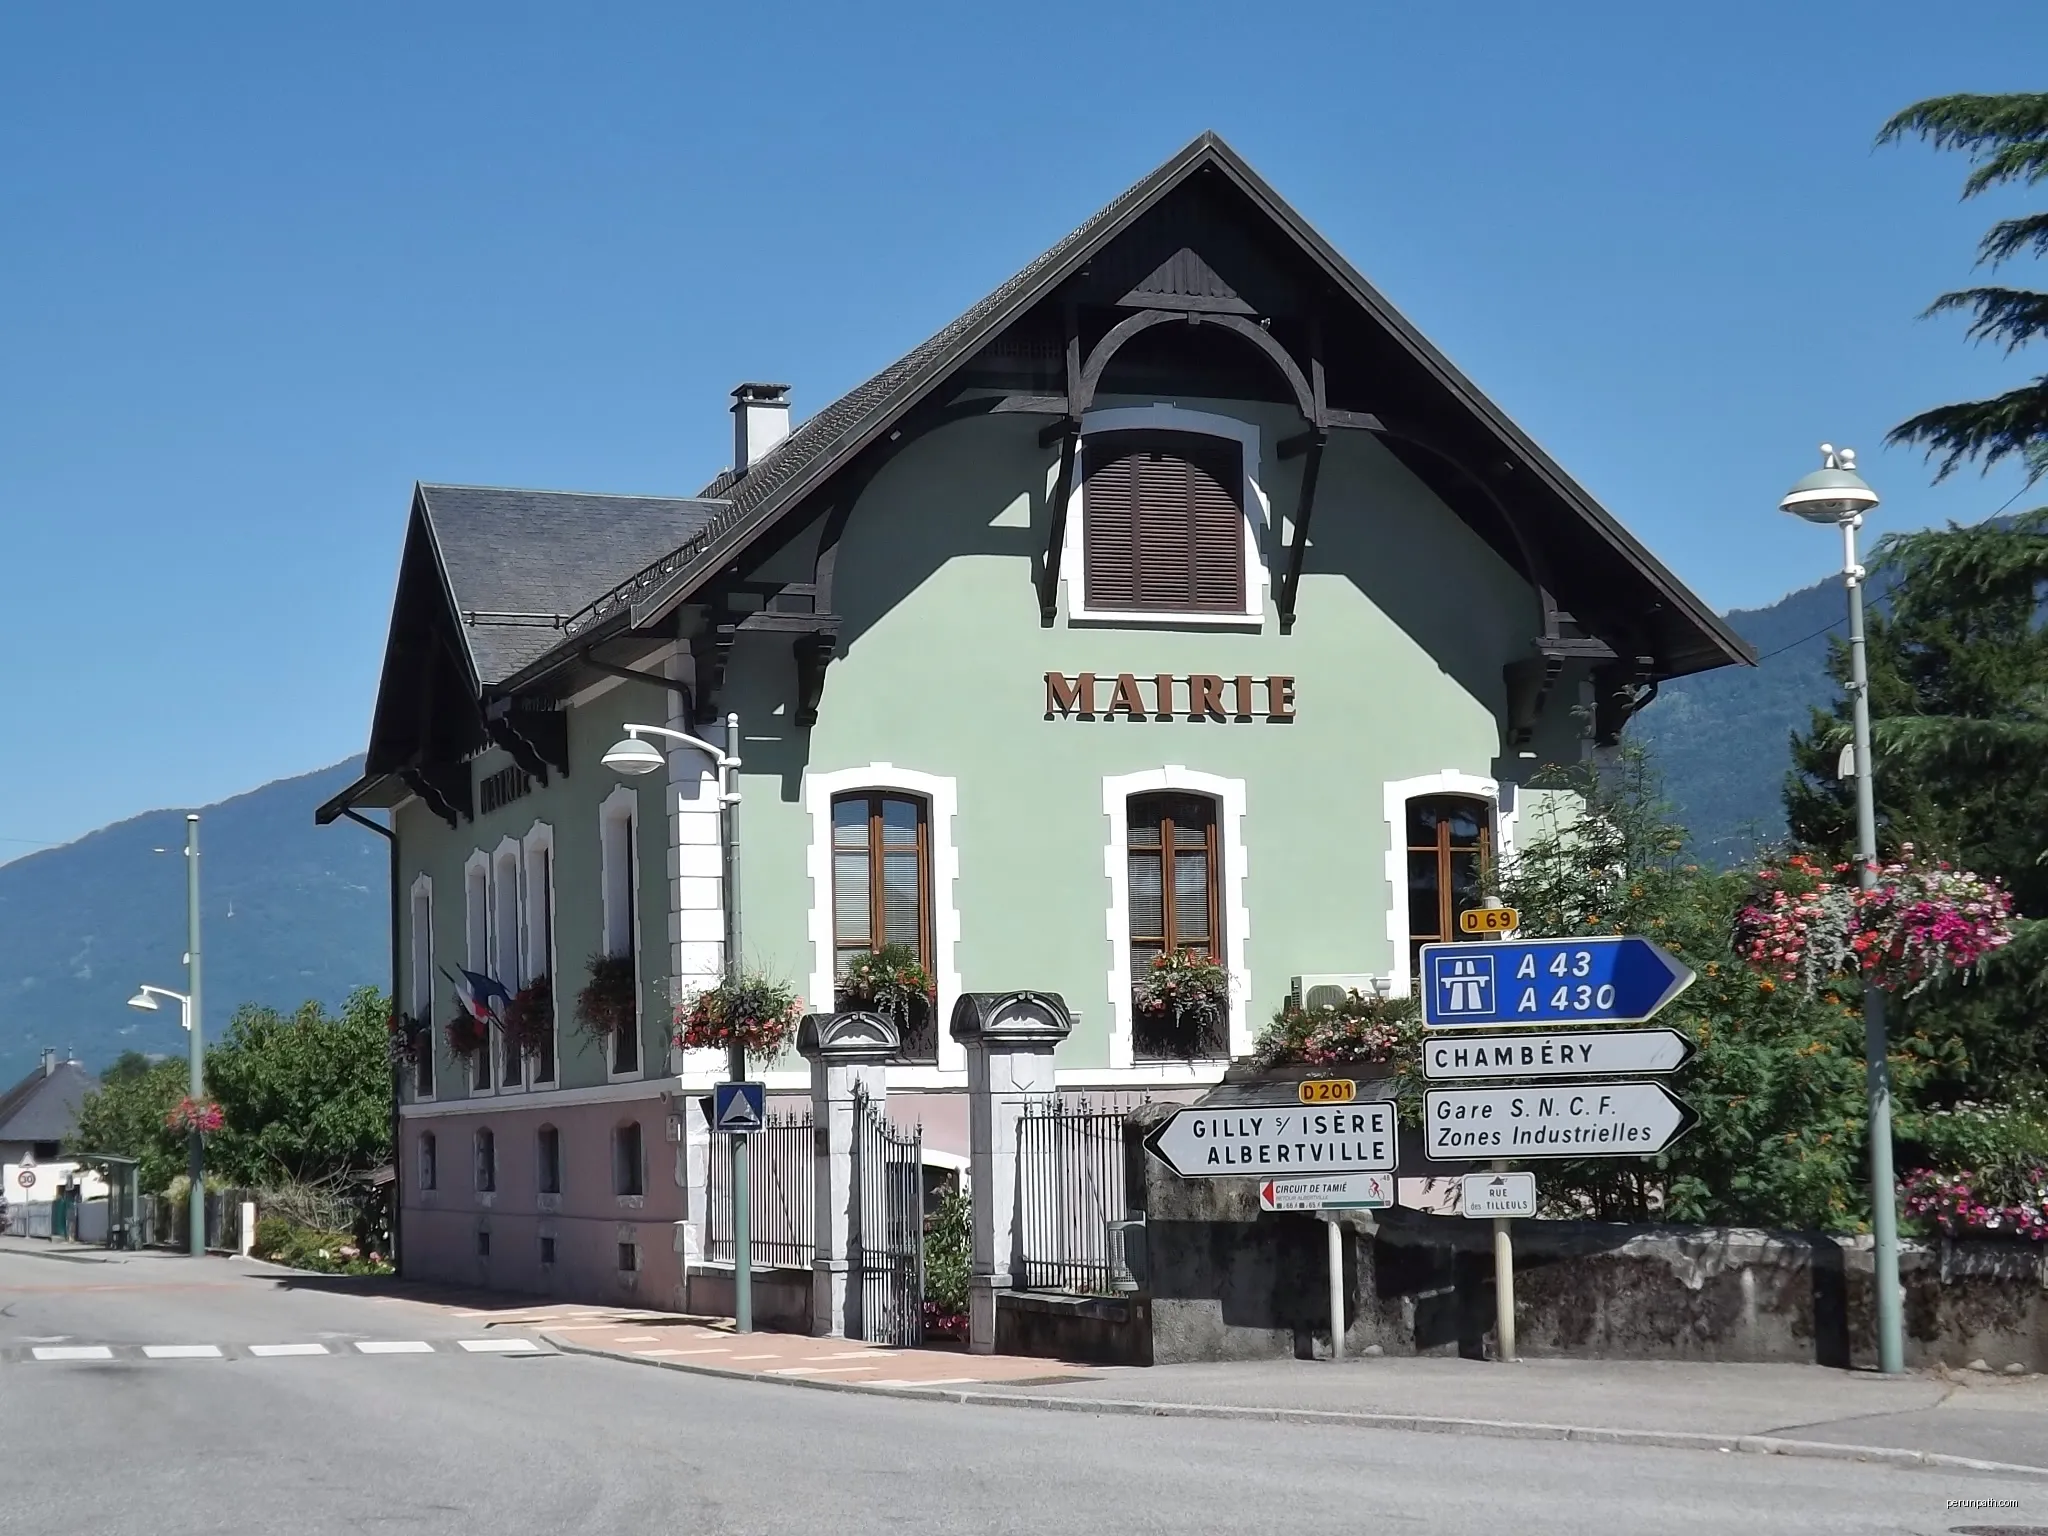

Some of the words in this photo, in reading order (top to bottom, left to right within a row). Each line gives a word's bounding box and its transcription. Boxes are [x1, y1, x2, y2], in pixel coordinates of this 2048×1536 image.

[1044, 672, 1296, 721] MAIRIE
[1467, 914, 1478, 929] D
[1486, 912, 1511, 928] 69
[1517, 953, 1536, 979] A
[1550, 951, 1592, 978] 43
[1518, 987, 1537, 1012] A
[1551, 984, 1616, 1011] 430
[1435, 1040, 1593, 1068] CHAMBÉRY
[1303, 1085, 1314, 1100] D
[1319, 1083, 1351, 1100] 201
[1437, 1100, 1493, 1120] Gare
[1193, 1117, 1263, 1138] GILLY
[1303, 1110, 1384, 1135] ISÈRE
[1438, 1127, 1501, 1147] Zones
[1512, 1122, 1652, 1145] Industrielles
[1207, 1141, 1385, 1165] ALBERTVILLE
[20, 1175, 33, 1184] 30
[1275, 1184, 1308, 1194] CIRCUIT
[1309, 1184, 1320, 1193] DE
[1322, 1182, 1347, 1193] TAMIÉ
[1489, 1188, 1508, 1197] RUE
[1470, 1202, 1482, 1211] des
[1486, 1200, 1528, 1210] TILLEULS
